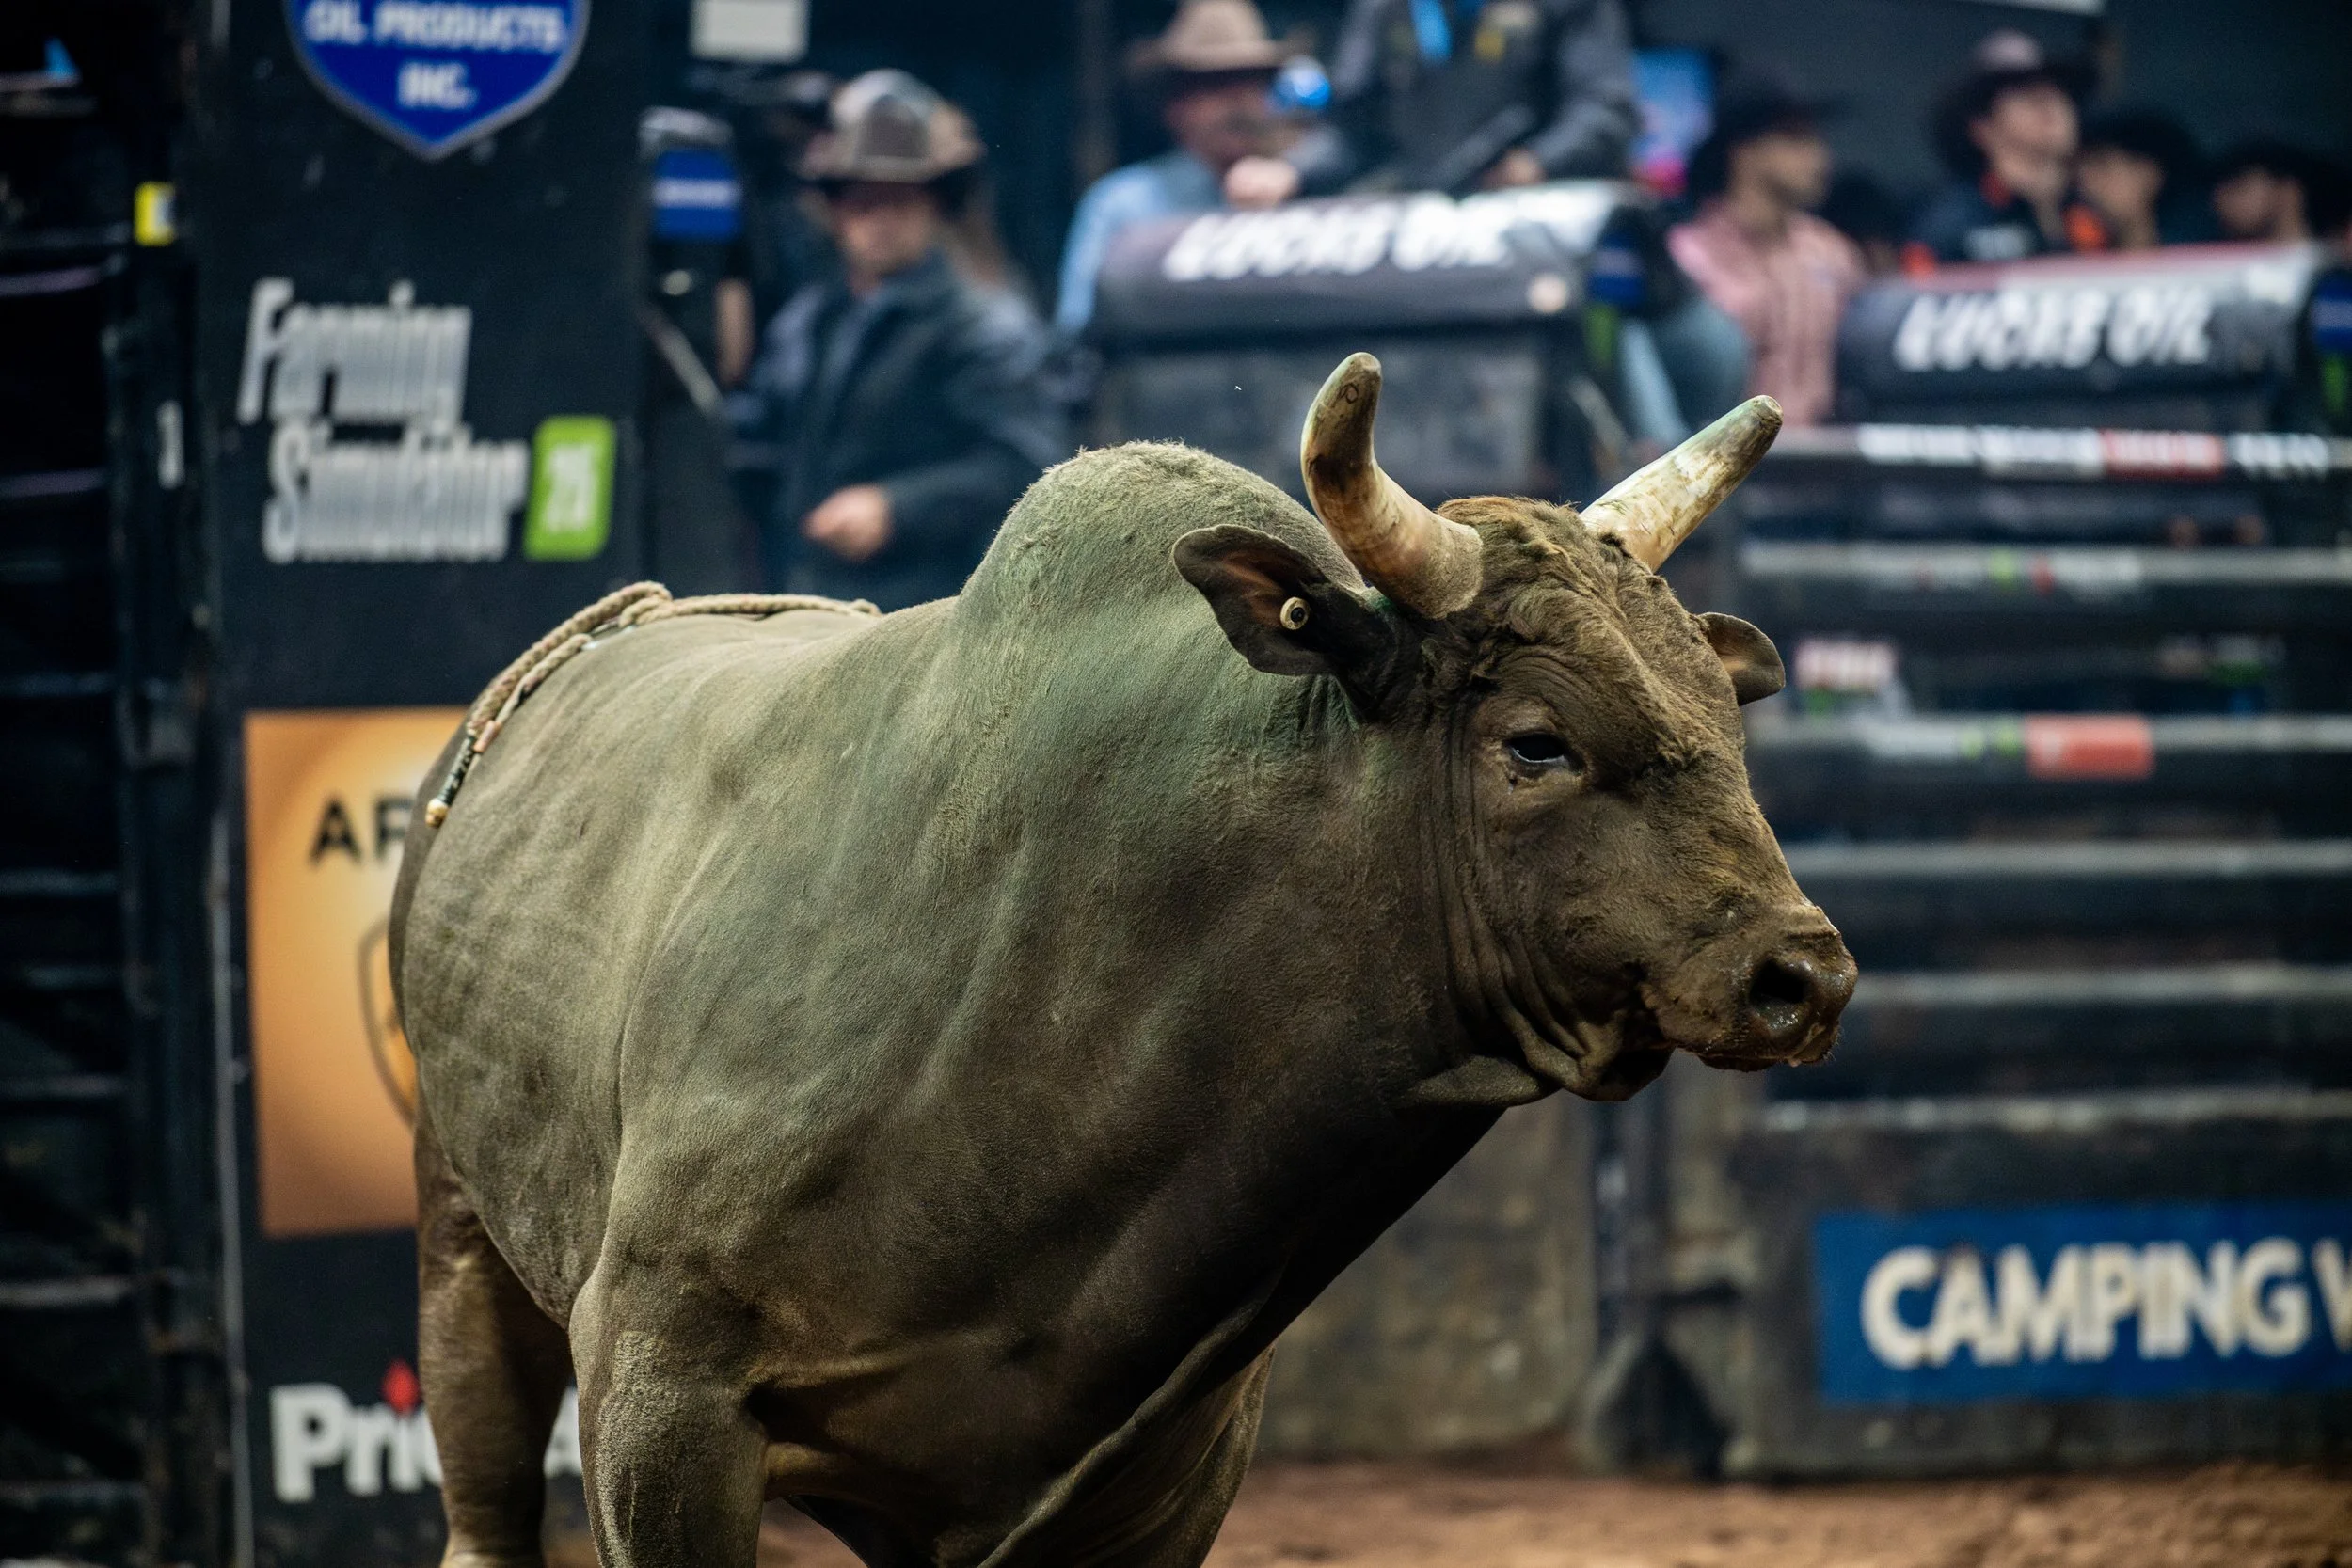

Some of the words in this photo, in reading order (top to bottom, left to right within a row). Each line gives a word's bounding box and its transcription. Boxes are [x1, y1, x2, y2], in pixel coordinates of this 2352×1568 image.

[375, 3, 563, 53] PRODUCTS
[237, 277, 471, 442] Farming
[263, 417, 530, 564] Simulator
[1862, 1239, 2308, 1369] CAMPING
